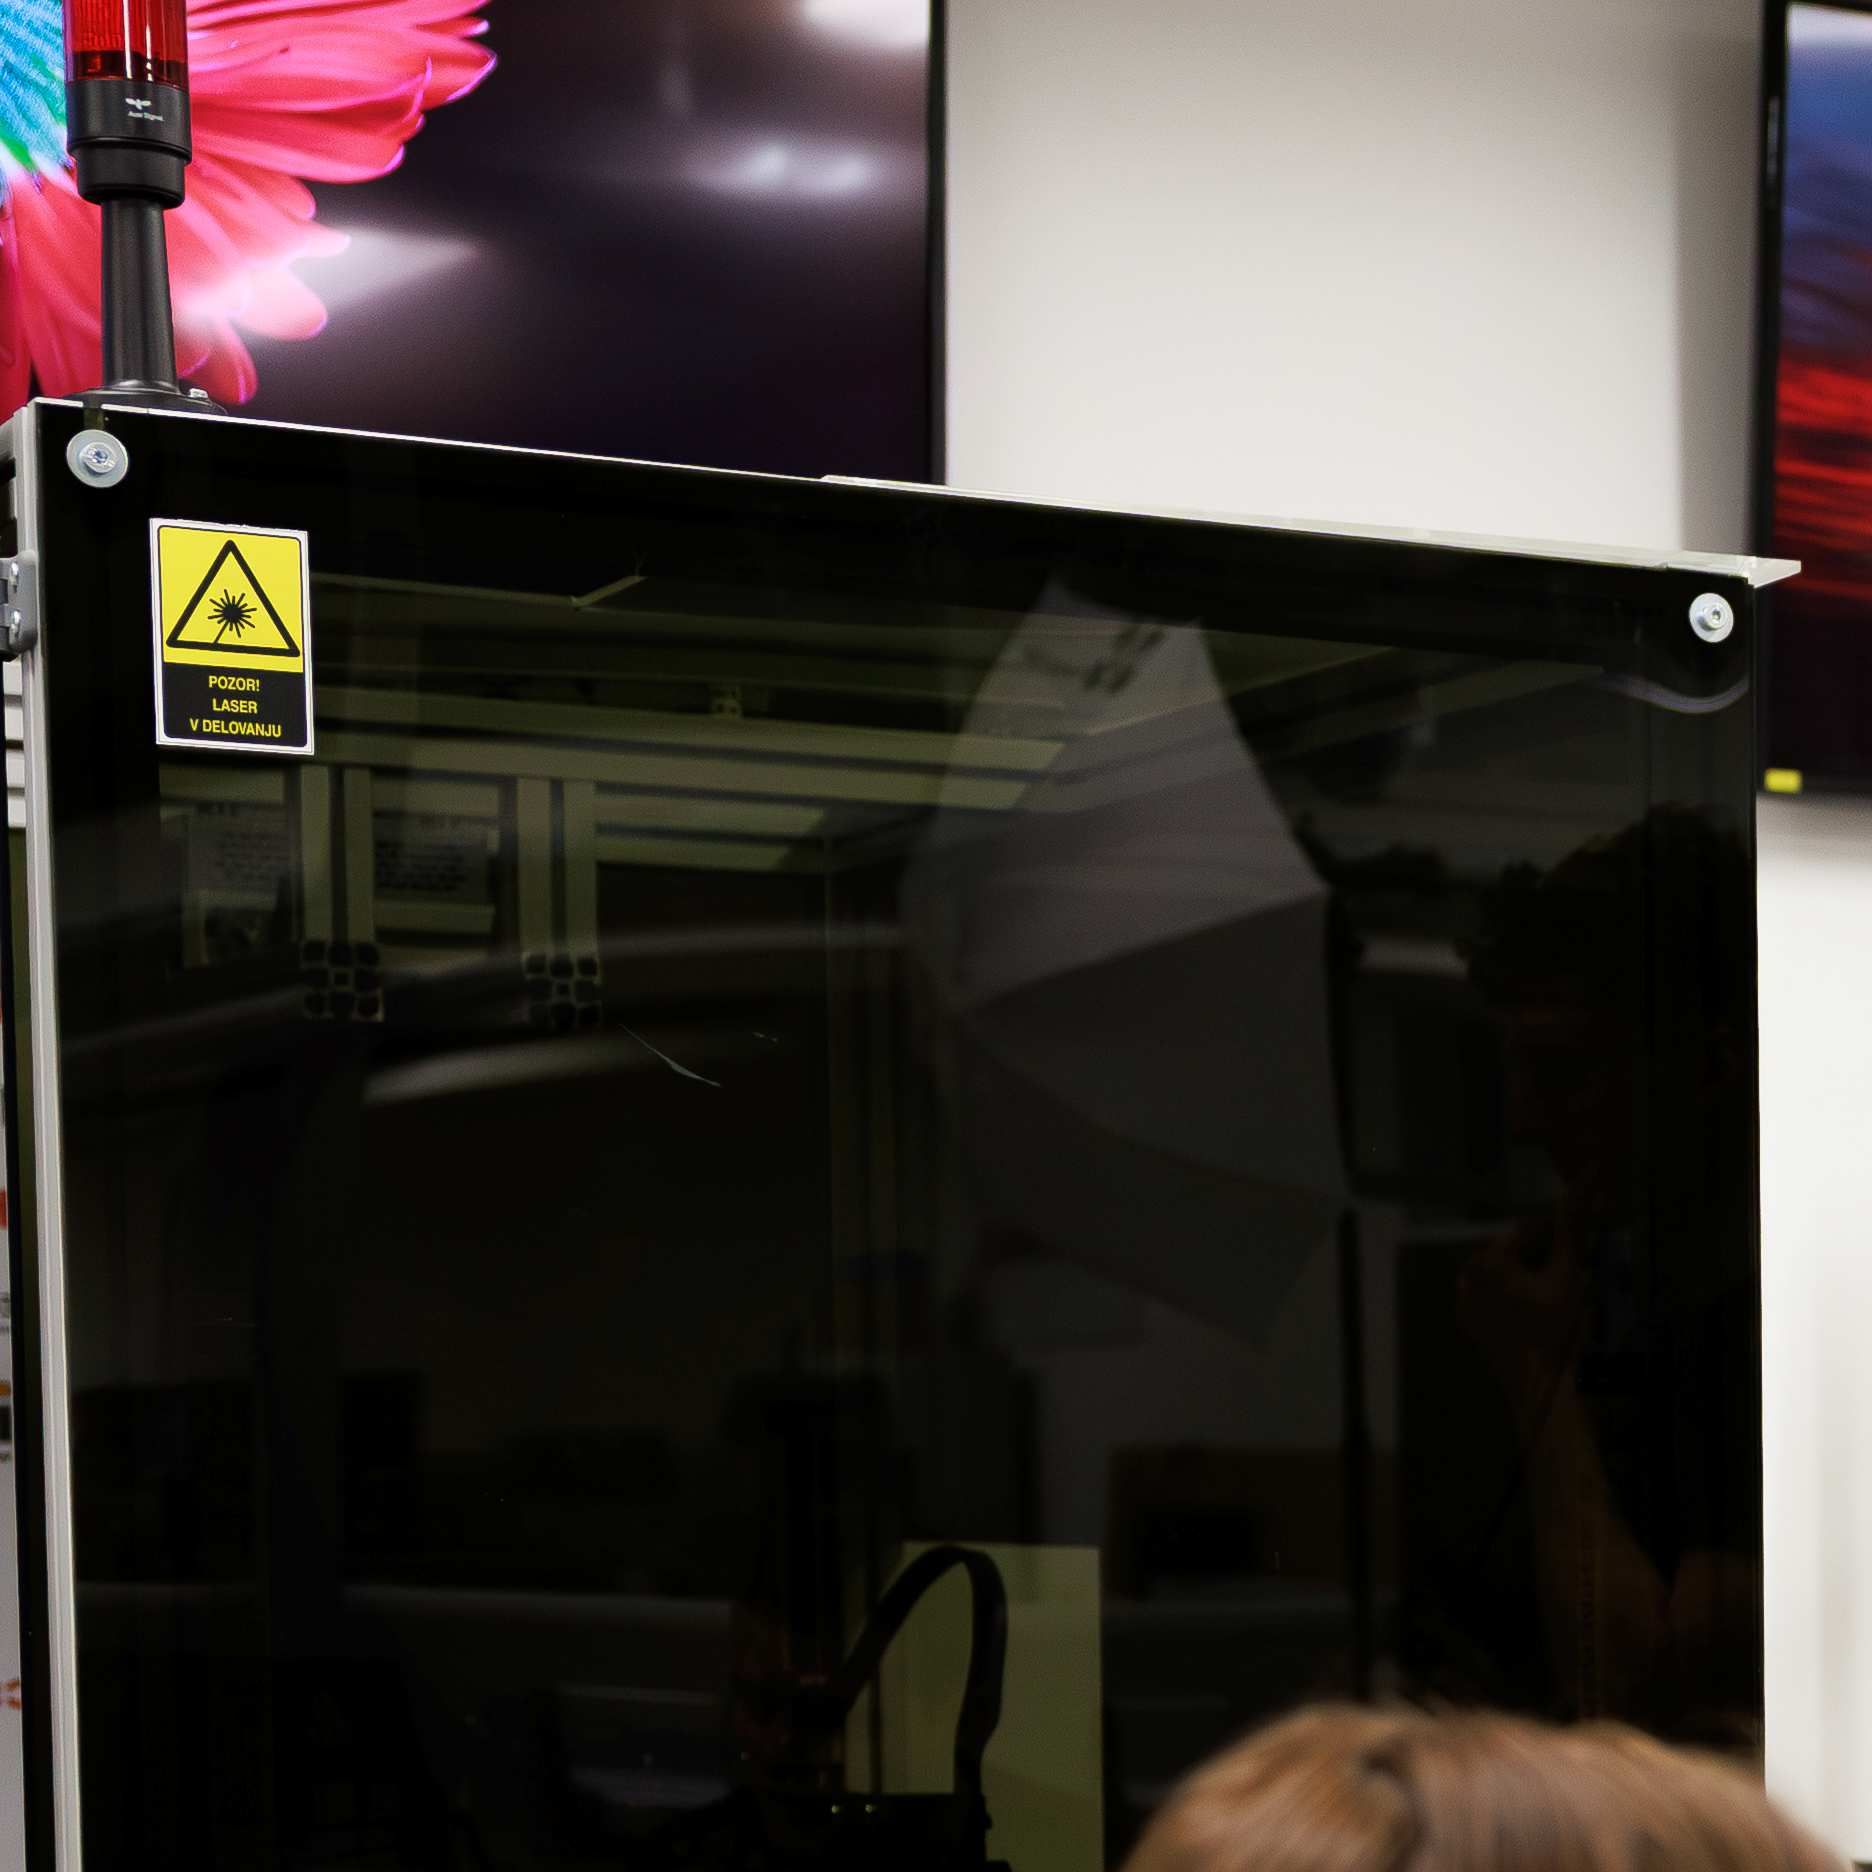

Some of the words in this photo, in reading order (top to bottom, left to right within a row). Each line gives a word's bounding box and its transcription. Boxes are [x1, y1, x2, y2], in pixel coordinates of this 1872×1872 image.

[208, 675, 260, 692] POZOR!
[212, 698, 258, 714] LASER
[189, 718, 199, 732] V
[202, 719, 282, 738] DELOVANJU
